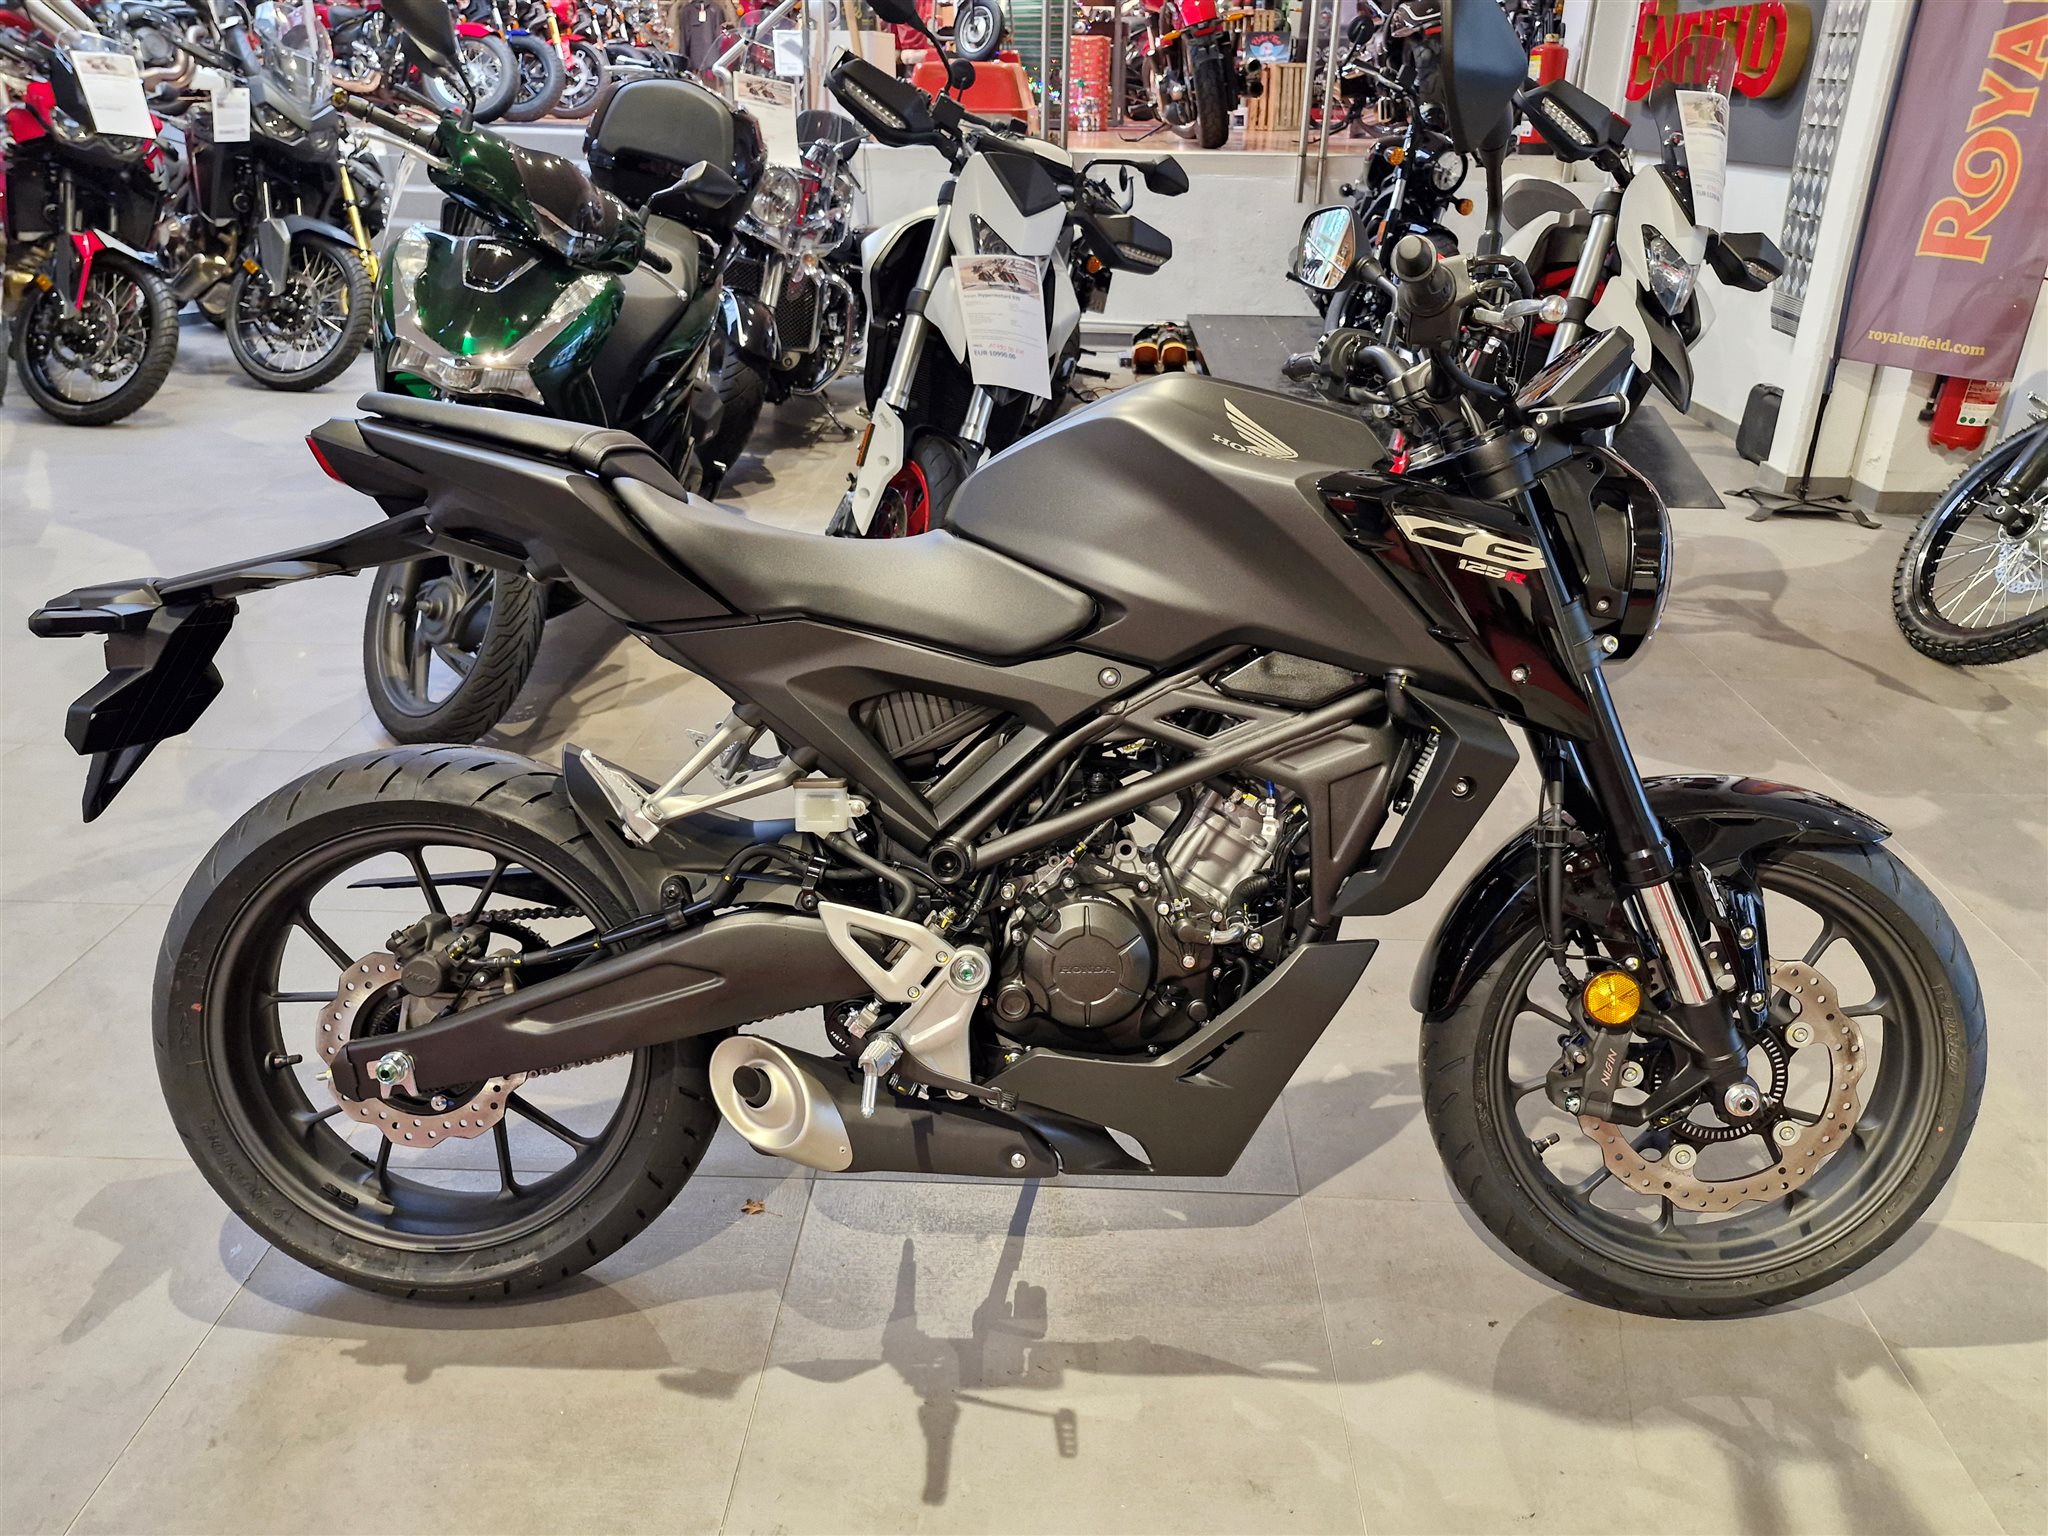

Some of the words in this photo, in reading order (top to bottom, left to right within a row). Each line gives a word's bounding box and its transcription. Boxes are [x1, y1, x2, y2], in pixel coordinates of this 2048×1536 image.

[1915, 2, 2048, 264] ROYA
[1867, 329, 1986, 356] royalenfield.com
[1393, 515, 1547, 570] CB
[1457, 558, 1527, 586] 125R
[1060, 966, 1116, 974] HONDA
